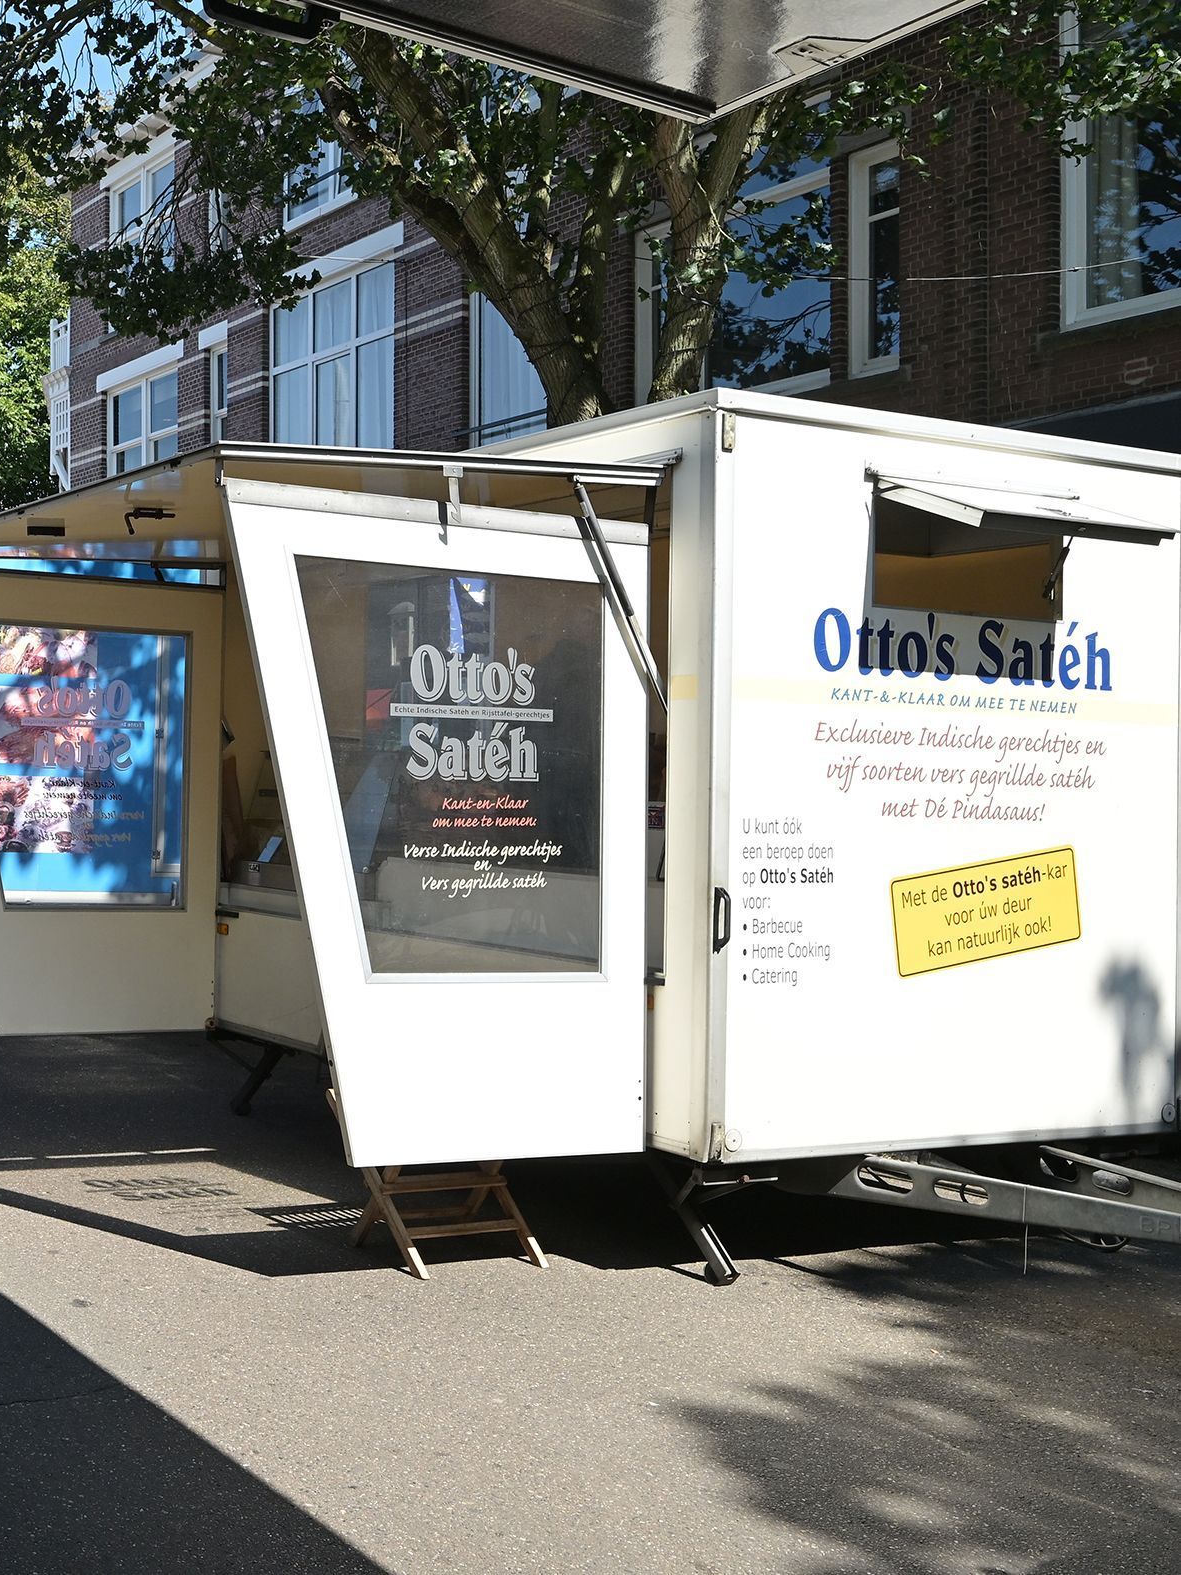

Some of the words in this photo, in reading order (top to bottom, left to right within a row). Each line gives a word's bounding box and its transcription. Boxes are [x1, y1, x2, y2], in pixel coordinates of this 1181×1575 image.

[813, 607, 957, 682] Otto's
[975, 619, 1113, 692] Satéh
[410, 644, 536, 706] Otto's
[394, 706, 415, 714] Echte
[416, 707, 448, 715] Indische
[830, 687, 946, 706] KANT-&-KLAAR
[949, 694, 971, 708] OM
[976, 696, 1005, 710] MEE
[1009, 698, 1027, 711] TE
[1029, 699, 1078, 714] NEMEN
[406, 722, 540, 782] Satéh
[814, 718, 915, 744] Exclusieve
[917, 723, 996, 750] Indische
[995, 729, 1081, 764] gerechtjes
[1085, 738, 1108, 757] en
[826, 754, 862, 793] vijf
[862, 761, 928, 784] soorten
[930, 767, 965, 785] vers
[965, 763, 1047, 798] gegrillde
[1049, 765, 1096, 789] satéh
[442, 794, 529, 811] Kant-en-Klaar
[880, 797, 919, 819] met
[924, 796, 949, 819] Dé
[952, 796, 1046, 822] Pindasaus!
[432, 817, 453, 828] om
[454, 817, 481, 828] mee
[481, 815, 494, 828] te
[495, 816, 538, 828] nemen:
[742, 818, 751, 834] U
[754, 818, 779, 834] kunt
[783, 817, 803, 834] óók
[403, 843, 439, 859] Verse
[440, 839, 496, 858] Indische
[498, 839, 563, 865] gerechtjes
[473, 858, 492, 872] en
[742, 846, 763, 860] een
[766, 843, 804, 863] beroep
[807, 843, 834, 860] doen
[421, 876, 452, 891] Vers
[448, 872, 512, 898] gegrillde
[512, 870, 548, 889] satéh
[742, 871, 756, 888] op
[760, 867, 797, 884] Otto's
[800, 866, 834, 884] Satéh
[901, 891, 927, 909] Met
[931, 885, 948, 903] de
[952, 875, 997, 898] Otto's
[1001, 863, 1068, 889] satéh-kar
[742, 896, 771, 910] voor:
[944, 907, 975, 927] voor
[979, 901, 998, 920] úw
[1002, 896, 1033, 915] deur
[752, 918, 804, 934] Barbecue
[927, 939, 953, 957] kan
[957, 923, 1021, 951] natuurlijk
[1024, 915, 1053, 937] ook!
[751, 943, 784, 959] Home
[787, 941, 831, 961] Cooking
[751, 967, 798, 987] Catering
